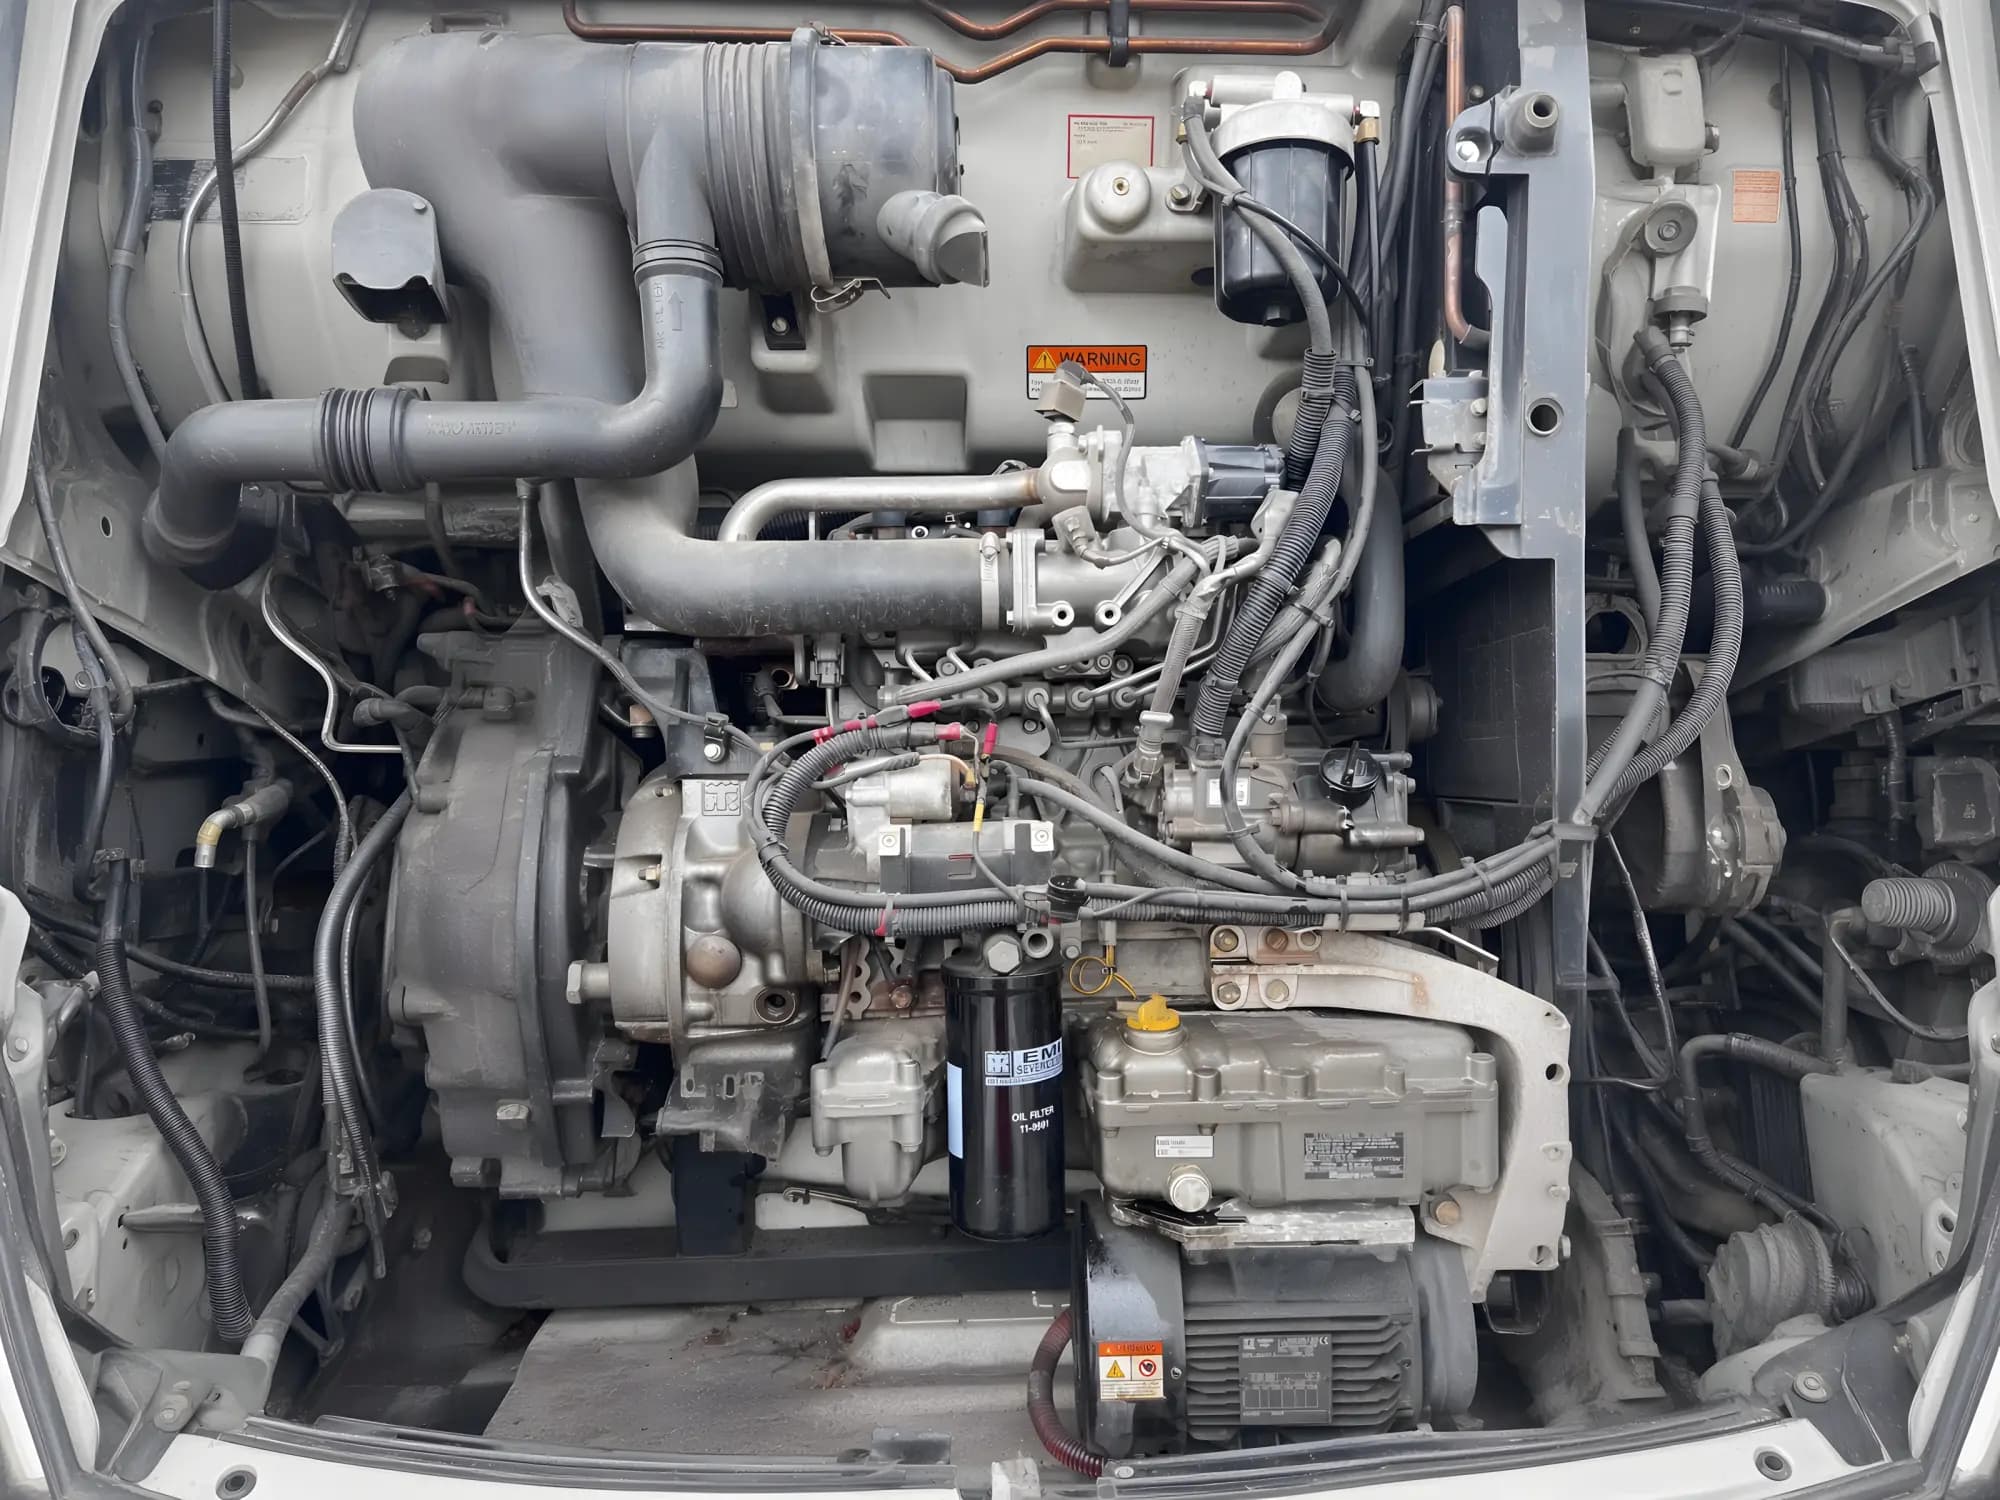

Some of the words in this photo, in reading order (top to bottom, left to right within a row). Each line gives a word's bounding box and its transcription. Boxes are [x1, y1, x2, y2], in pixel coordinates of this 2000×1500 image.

[1059, 351, 1141, 367] WARNING
[1011, 1112, 1028, 1122] OIL
[1030, 1105, 1054, 1120] FILTER
